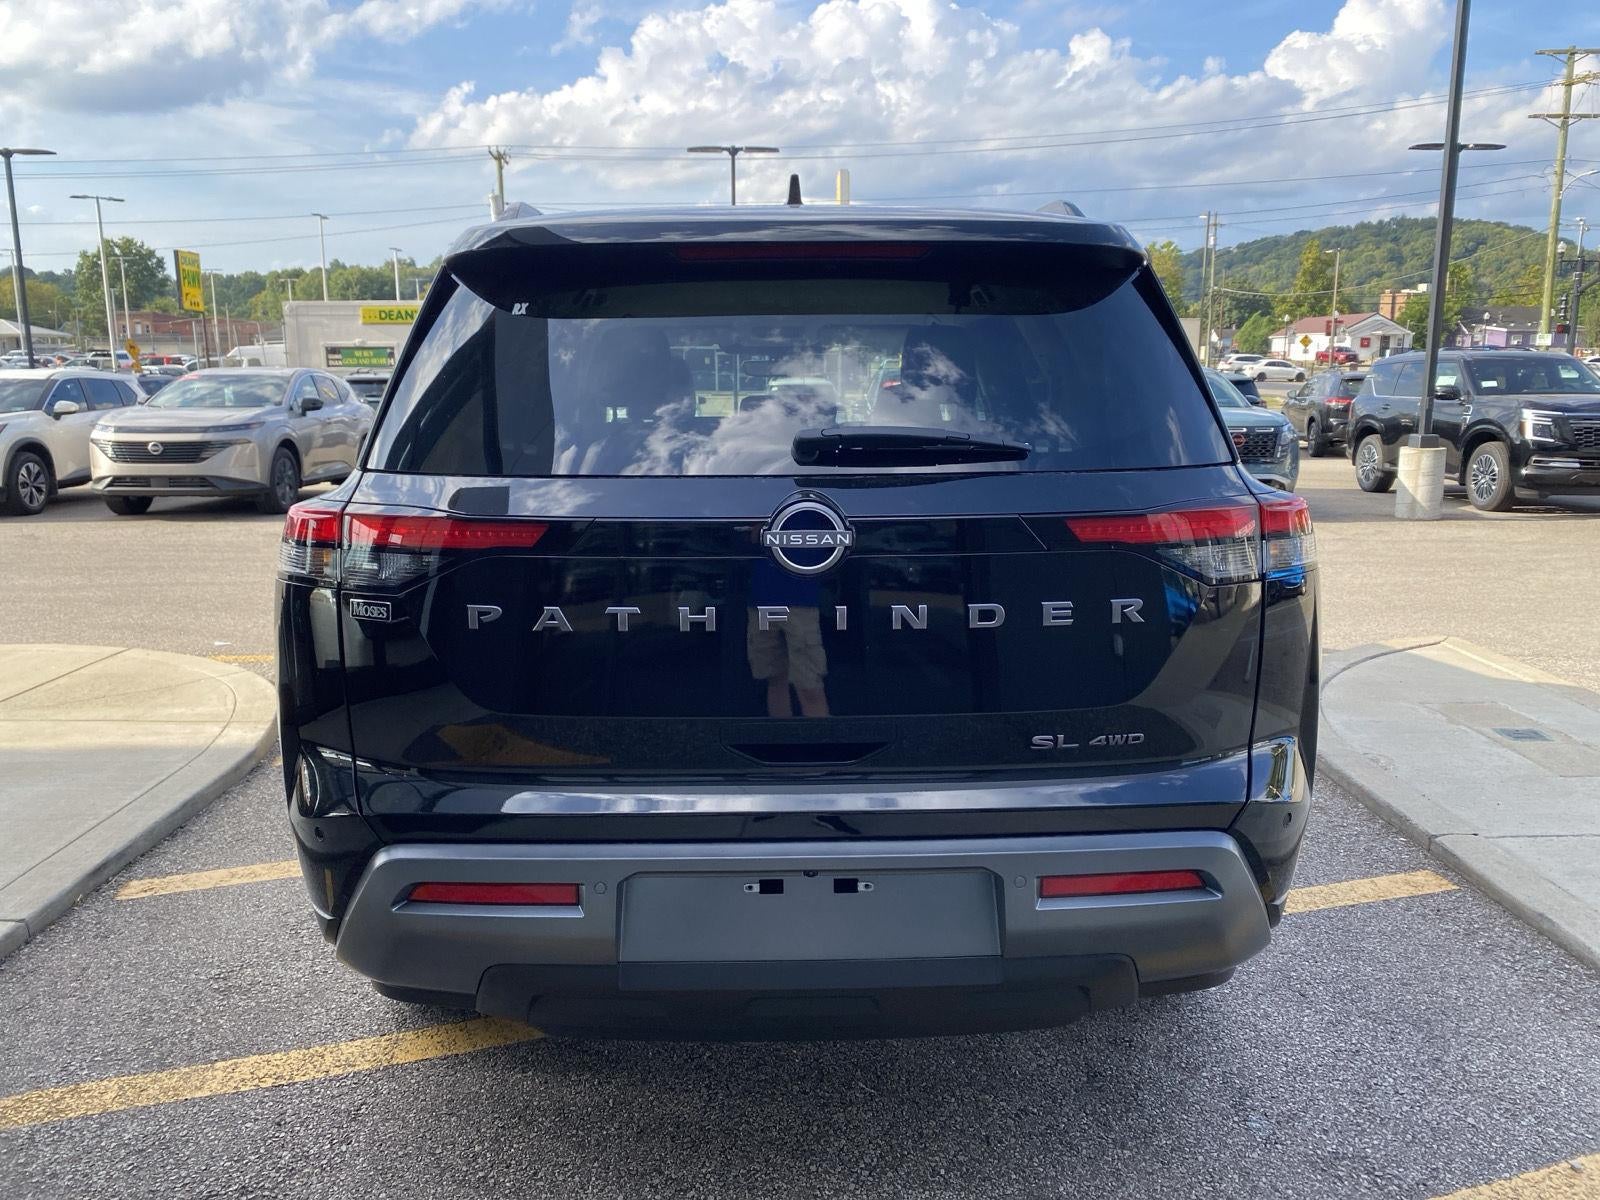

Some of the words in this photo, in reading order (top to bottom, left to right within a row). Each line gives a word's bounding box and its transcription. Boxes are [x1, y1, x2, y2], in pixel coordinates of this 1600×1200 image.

[511, 302, 529, 315] RX
[766, 533, 850, 546] NISSAN
[466, 597, 1146, 633] PATHFINDER
[1030, 734, 1080, 750] SL
[1088, 733, 1145, 746] 4WD
